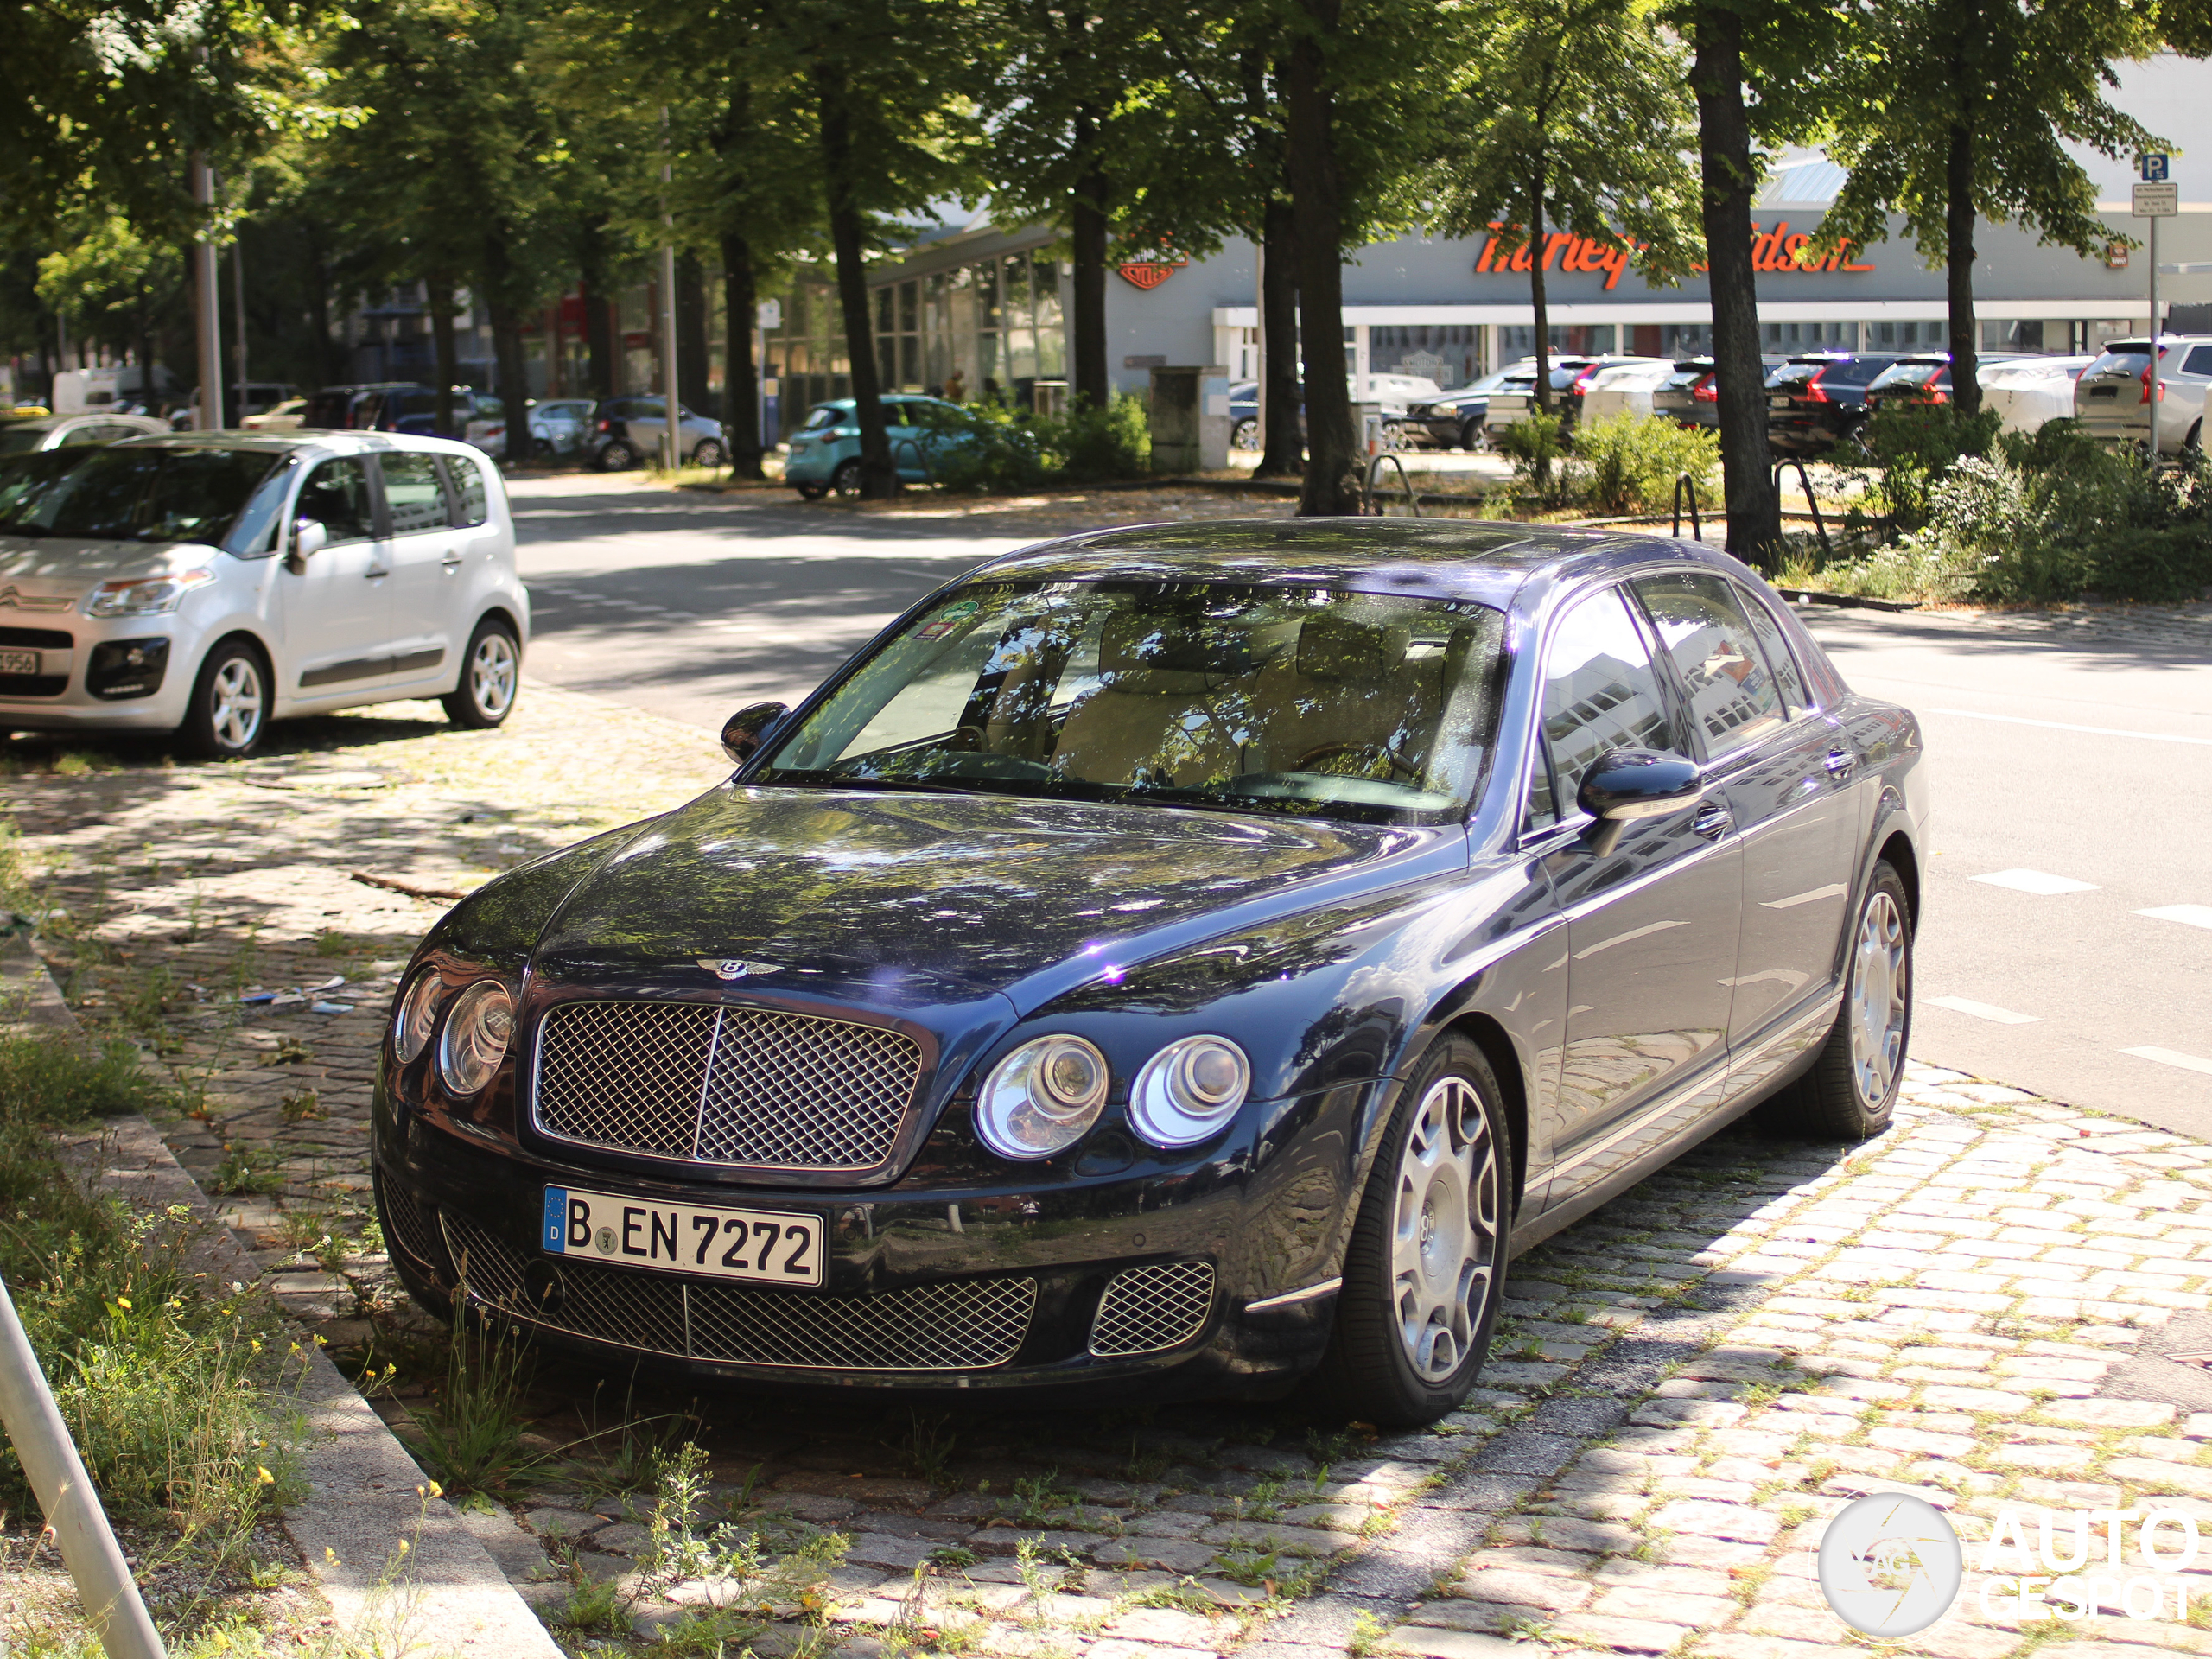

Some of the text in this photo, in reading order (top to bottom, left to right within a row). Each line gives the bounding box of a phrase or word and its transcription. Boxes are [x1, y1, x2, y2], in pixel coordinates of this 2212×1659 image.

[2147, 156, 2163, 178] P
[550, 1225, 559, 1241] D
[567, 1198, 592, 1248] B
[622, 1206, 678, 1262] EN
[692, 1215, 812, 1275] 7272
